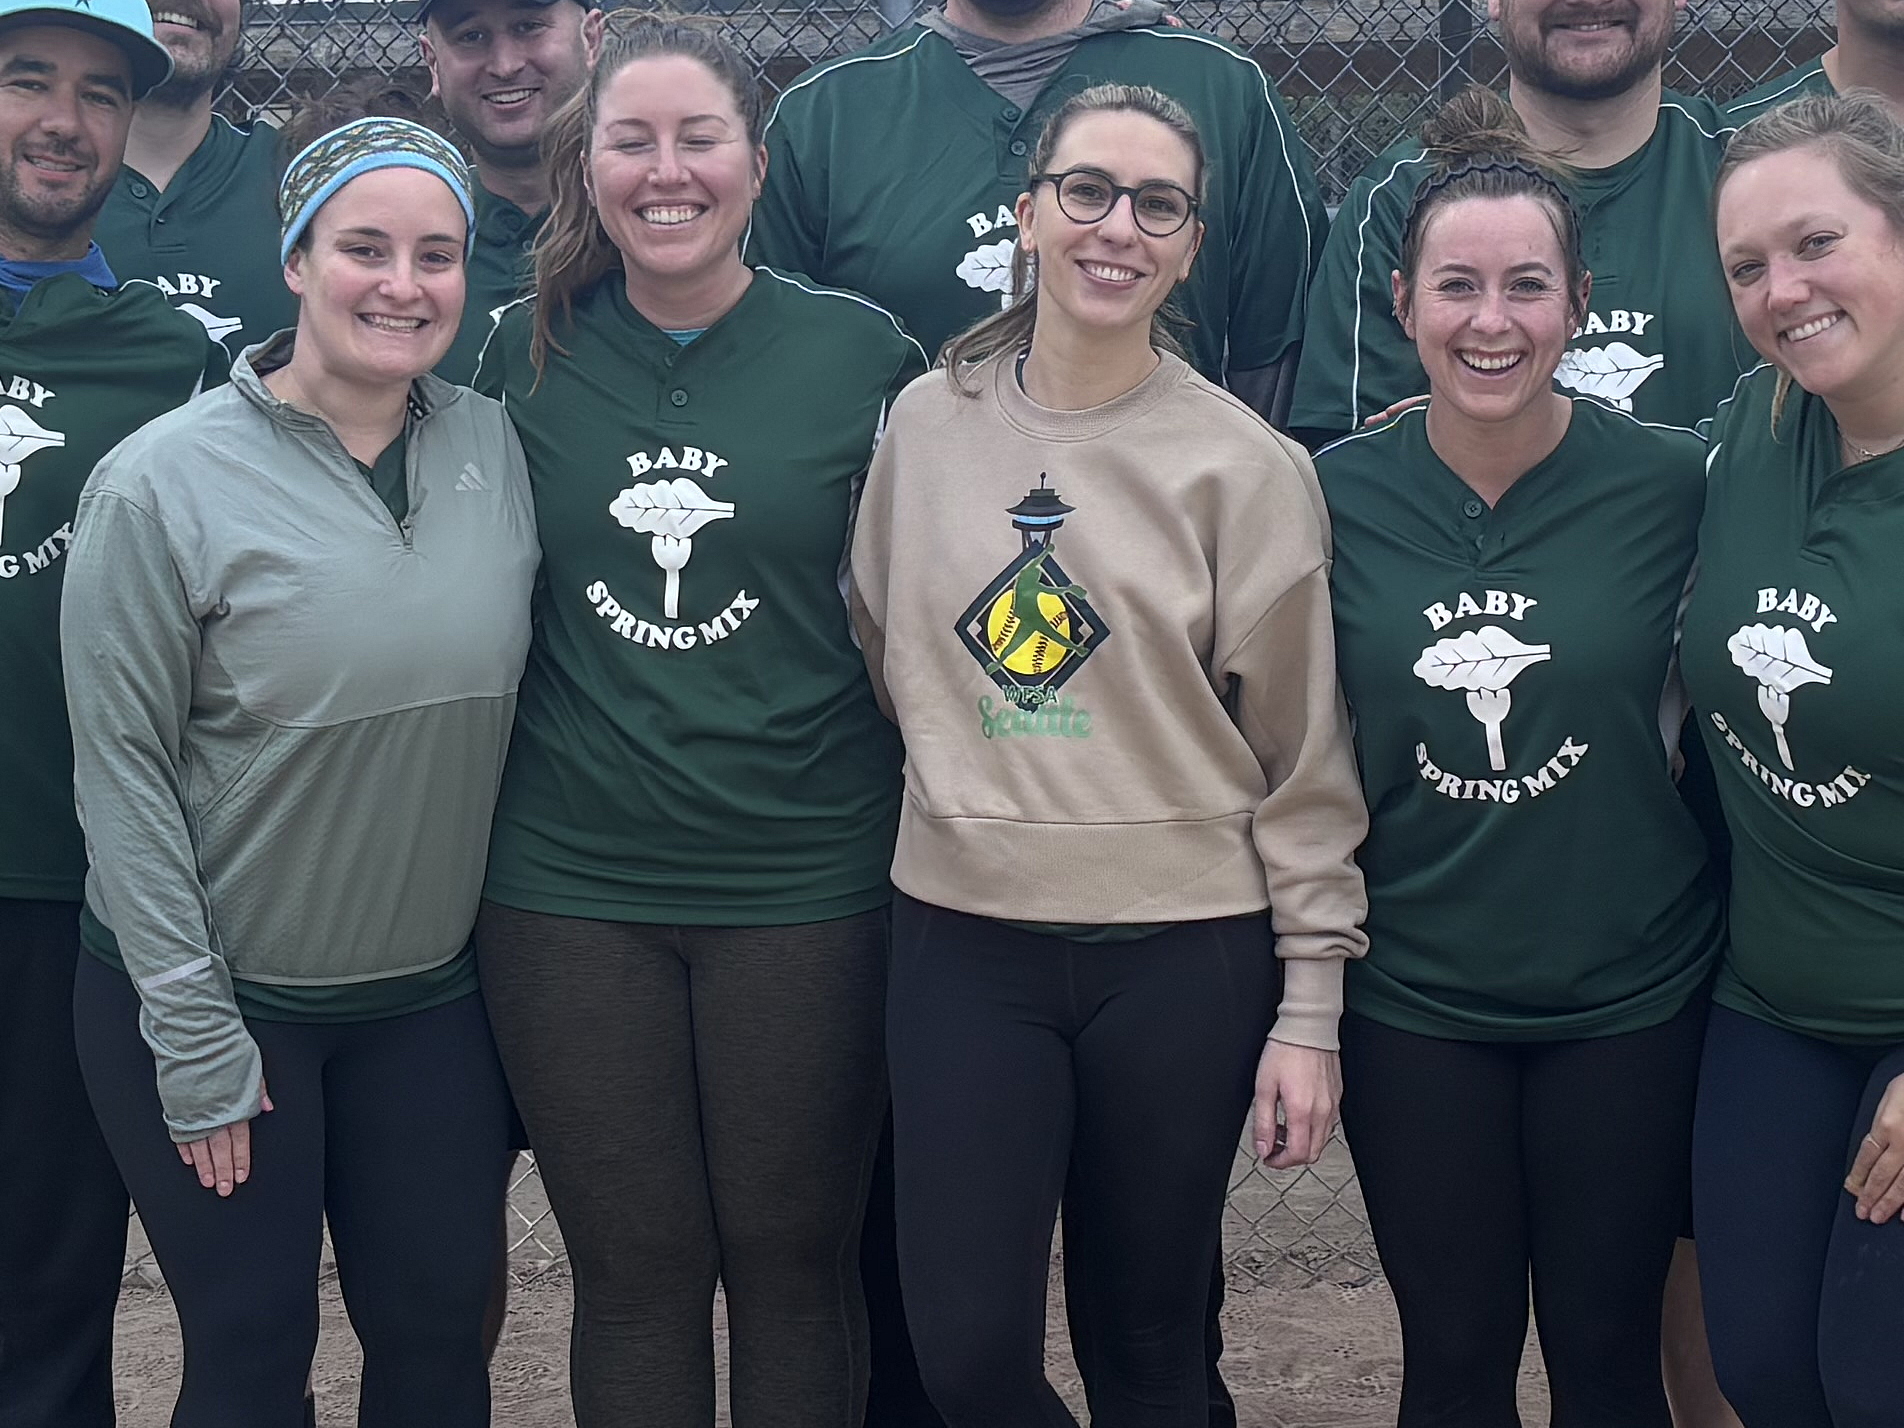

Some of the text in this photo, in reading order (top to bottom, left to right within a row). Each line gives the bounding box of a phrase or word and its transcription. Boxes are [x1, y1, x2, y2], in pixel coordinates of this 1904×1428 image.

[966, 205, 1018, 238] BA
[157, 273, 221, 298] ABY
[1572, 310, 1654, 340] ABY
[626, 446, 728, 477] BABY
[586, 580, 760, 649] SPRING MIX
[1423, 590, 1537, 631] BABY
[1757, 587, 1837, 632] BABY
[1415, 736, 1589, 804] SPRING MIX
[1710, 711, 1816, 807] SPRING
